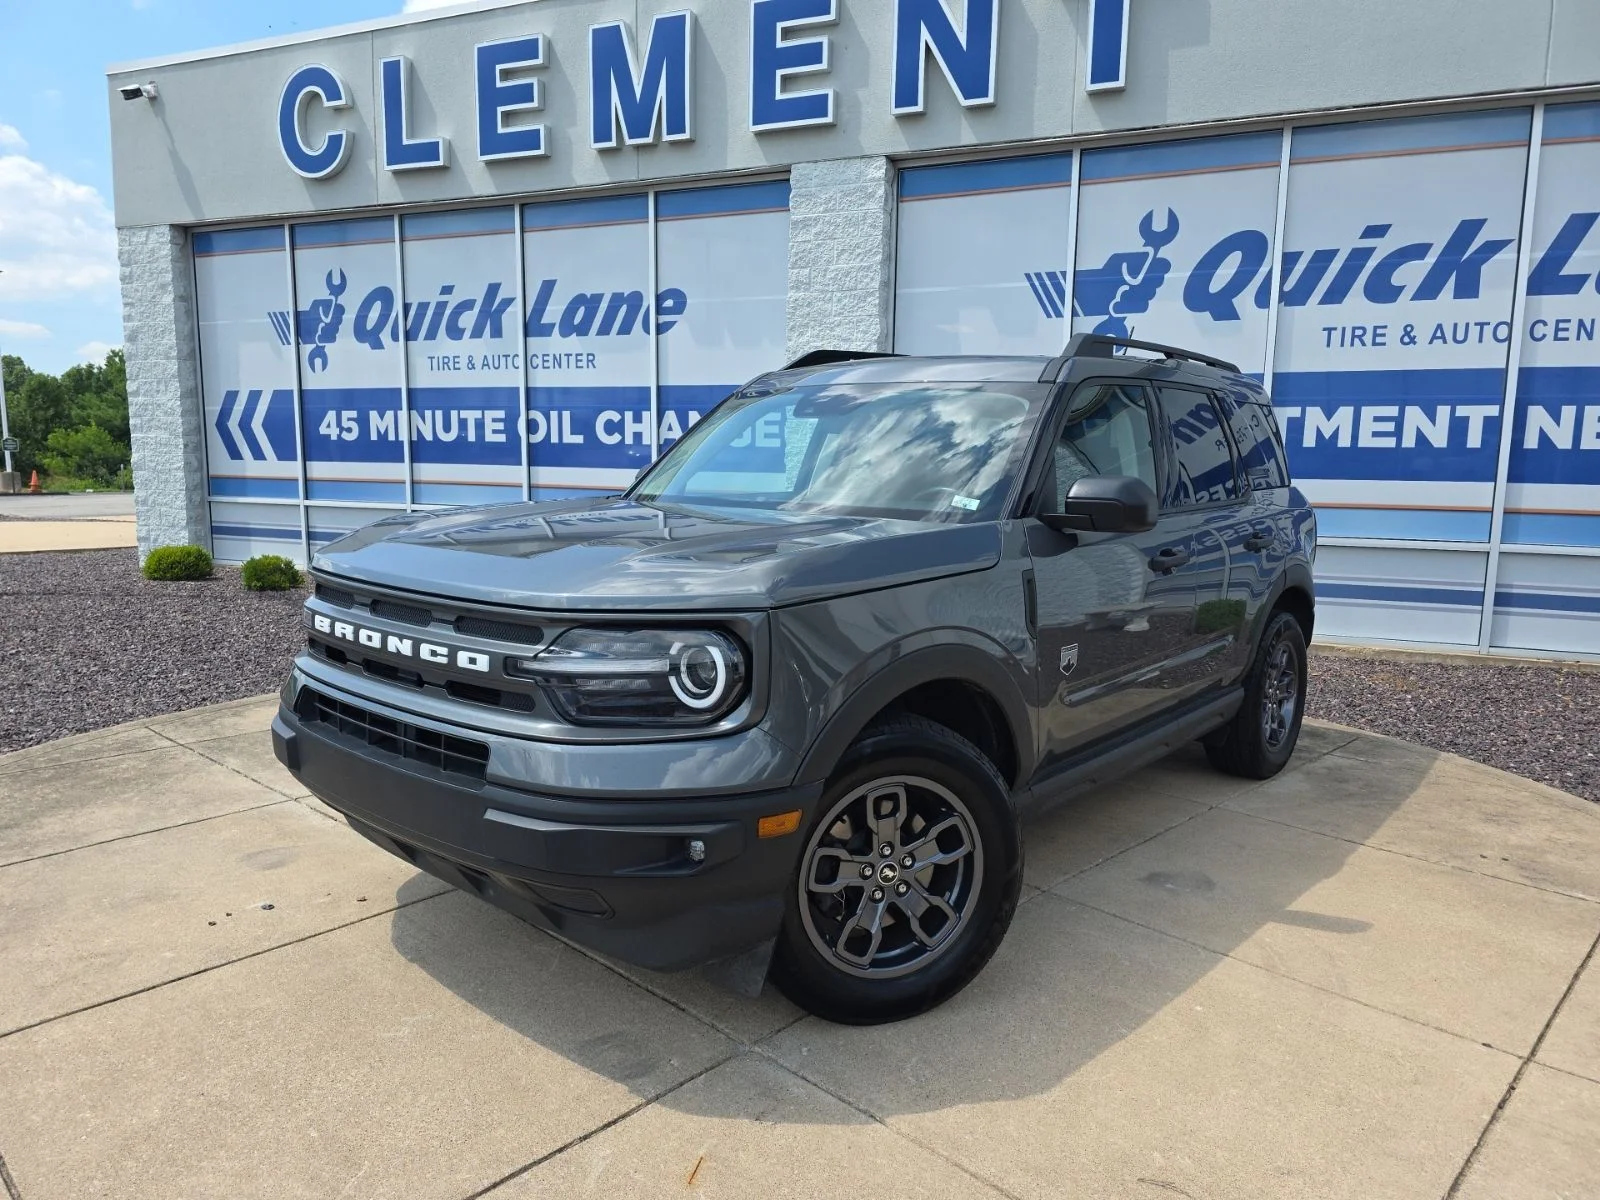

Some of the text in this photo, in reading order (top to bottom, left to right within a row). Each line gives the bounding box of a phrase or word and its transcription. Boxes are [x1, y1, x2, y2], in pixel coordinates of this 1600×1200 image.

[1183, 212, 1600, 321] Quick L
[353, 279, 688, 350] Quick Lane
[1322, 325, 1388, 348] TIRE
[1400, 323, 1418, 346] &
[1428, 320, 1511, 346] AUTO
[428, 353, 597, 371] TIRE & AUTO CENTER
[318, 410, 359, 442] 45
[369, 409, 507, 443] MINUTE
[517, 409, 585, 445] OIL
[314, 614, 490, 673] BRONCO
